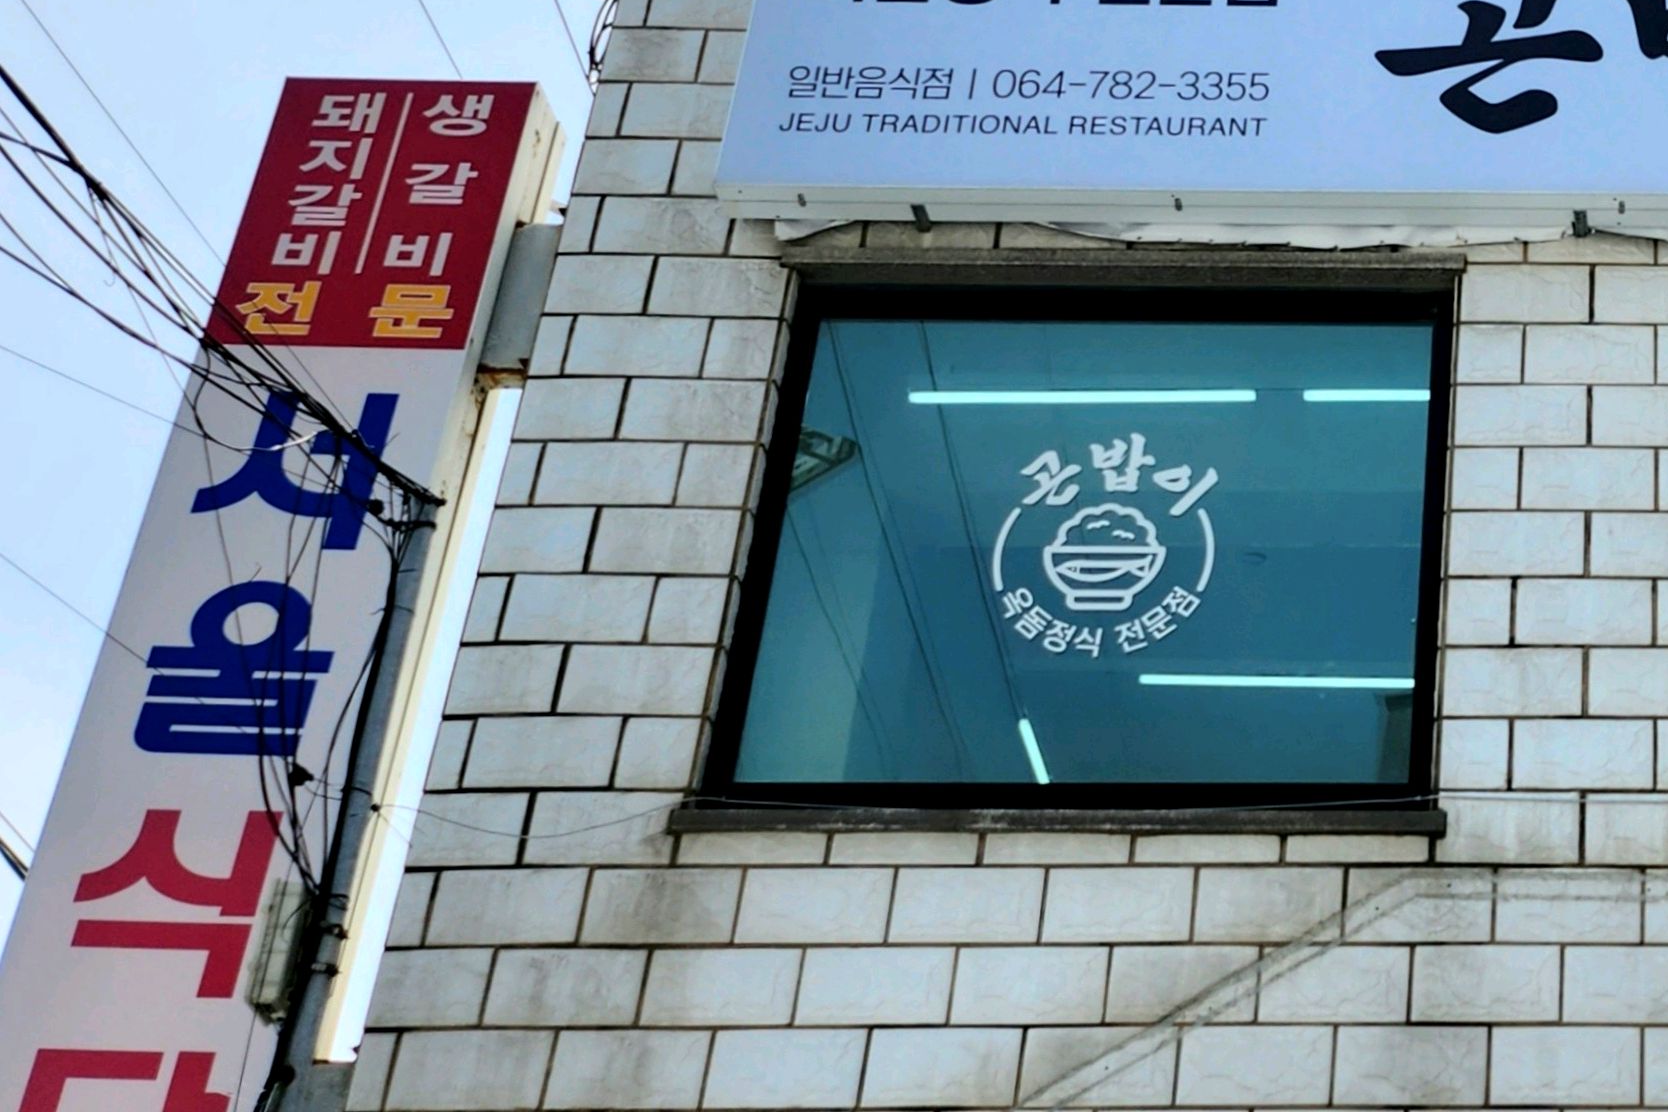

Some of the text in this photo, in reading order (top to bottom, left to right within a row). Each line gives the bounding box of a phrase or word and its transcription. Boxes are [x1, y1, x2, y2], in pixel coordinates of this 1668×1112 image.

[787, 65, 1271, 102] 일반음식점 064-782-3355
[778, 113, 1269, 138] JEJU TRADITIONAL RESTAURANT
[271, 92, 387, 275] 돼지갈비
[383, 93, 494, 277] 생갈비
[1020, 432, 1219, 517] 곤밥이
[1001, 585, 1201, 658] 옥돔정식 전문점
